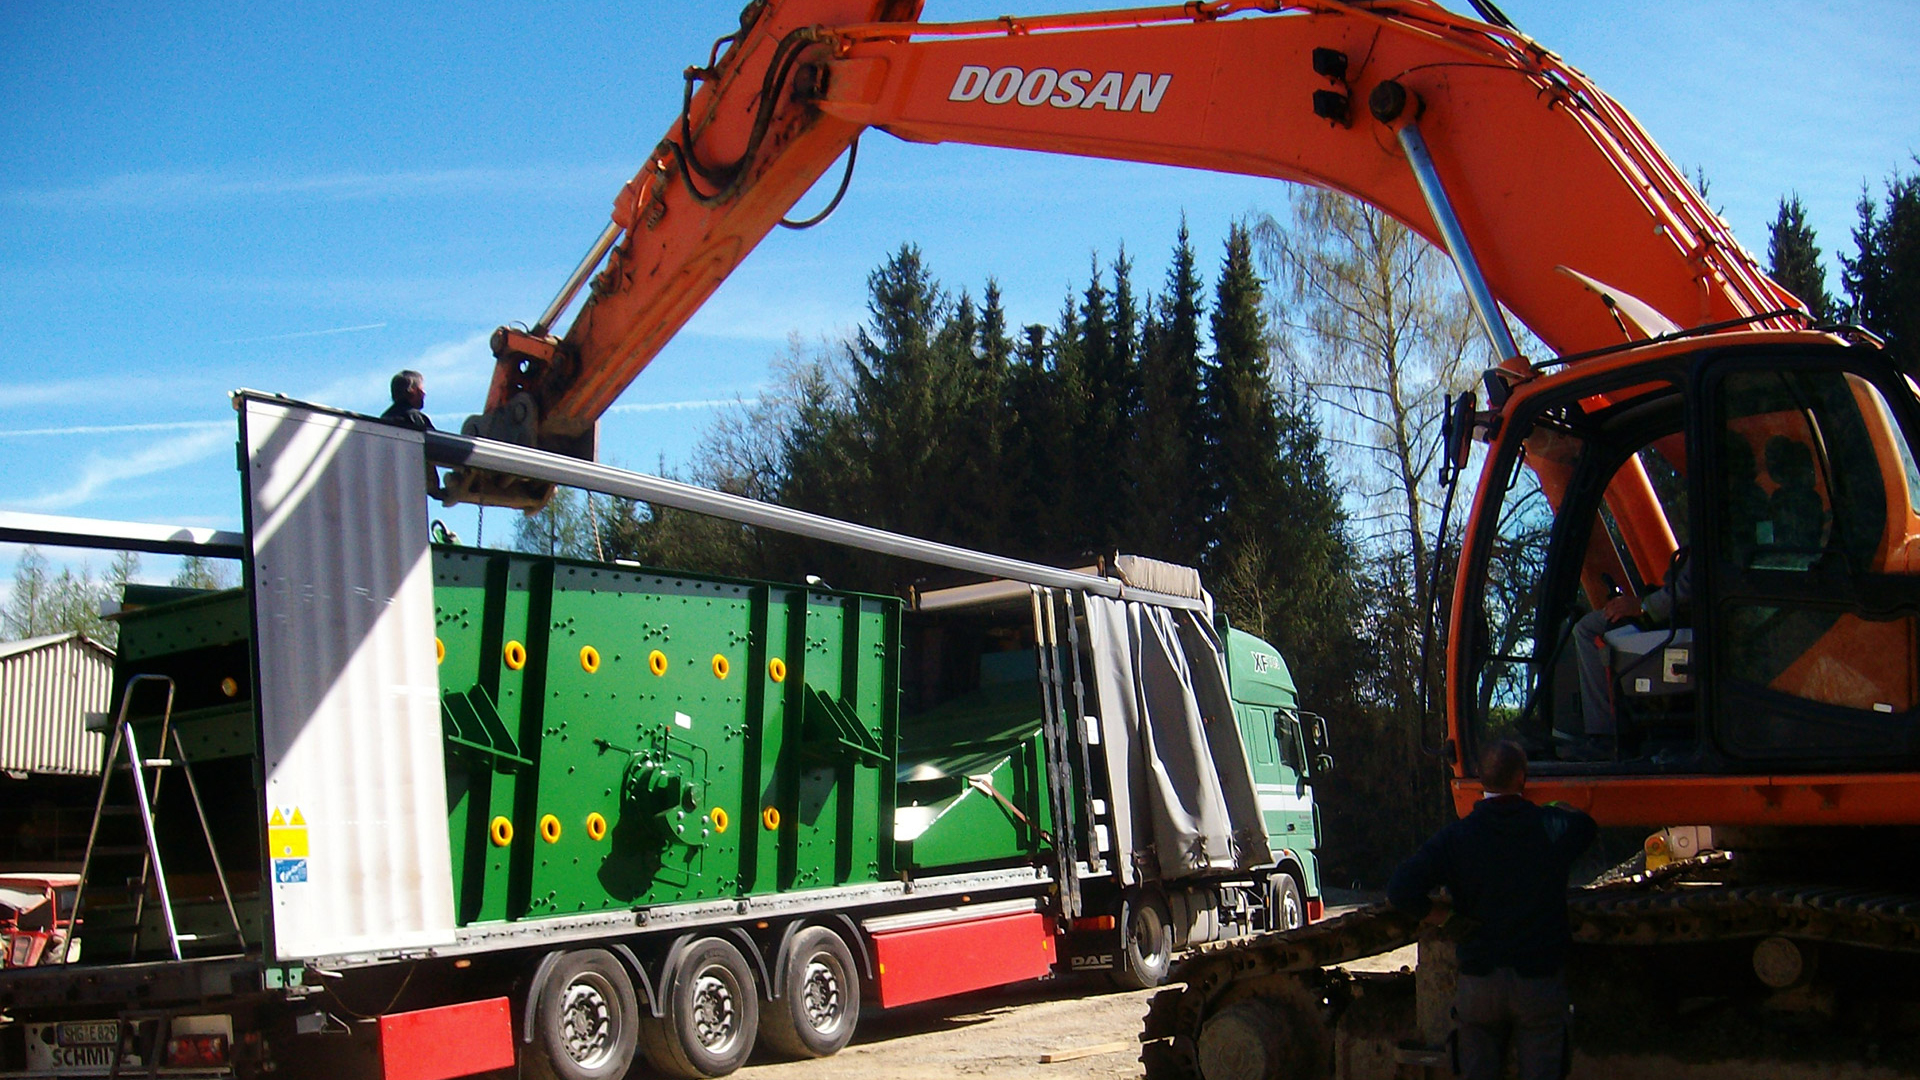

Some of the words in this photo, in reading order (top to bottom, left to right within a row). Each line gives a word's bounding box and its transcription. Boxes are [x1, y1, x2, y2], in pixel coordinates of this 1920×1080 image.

[948, 65, 1173, 113] DOOSAN
[1071, 954, 1113, 966] DAF
[52, 1047, 131, 1067] SCHMI
